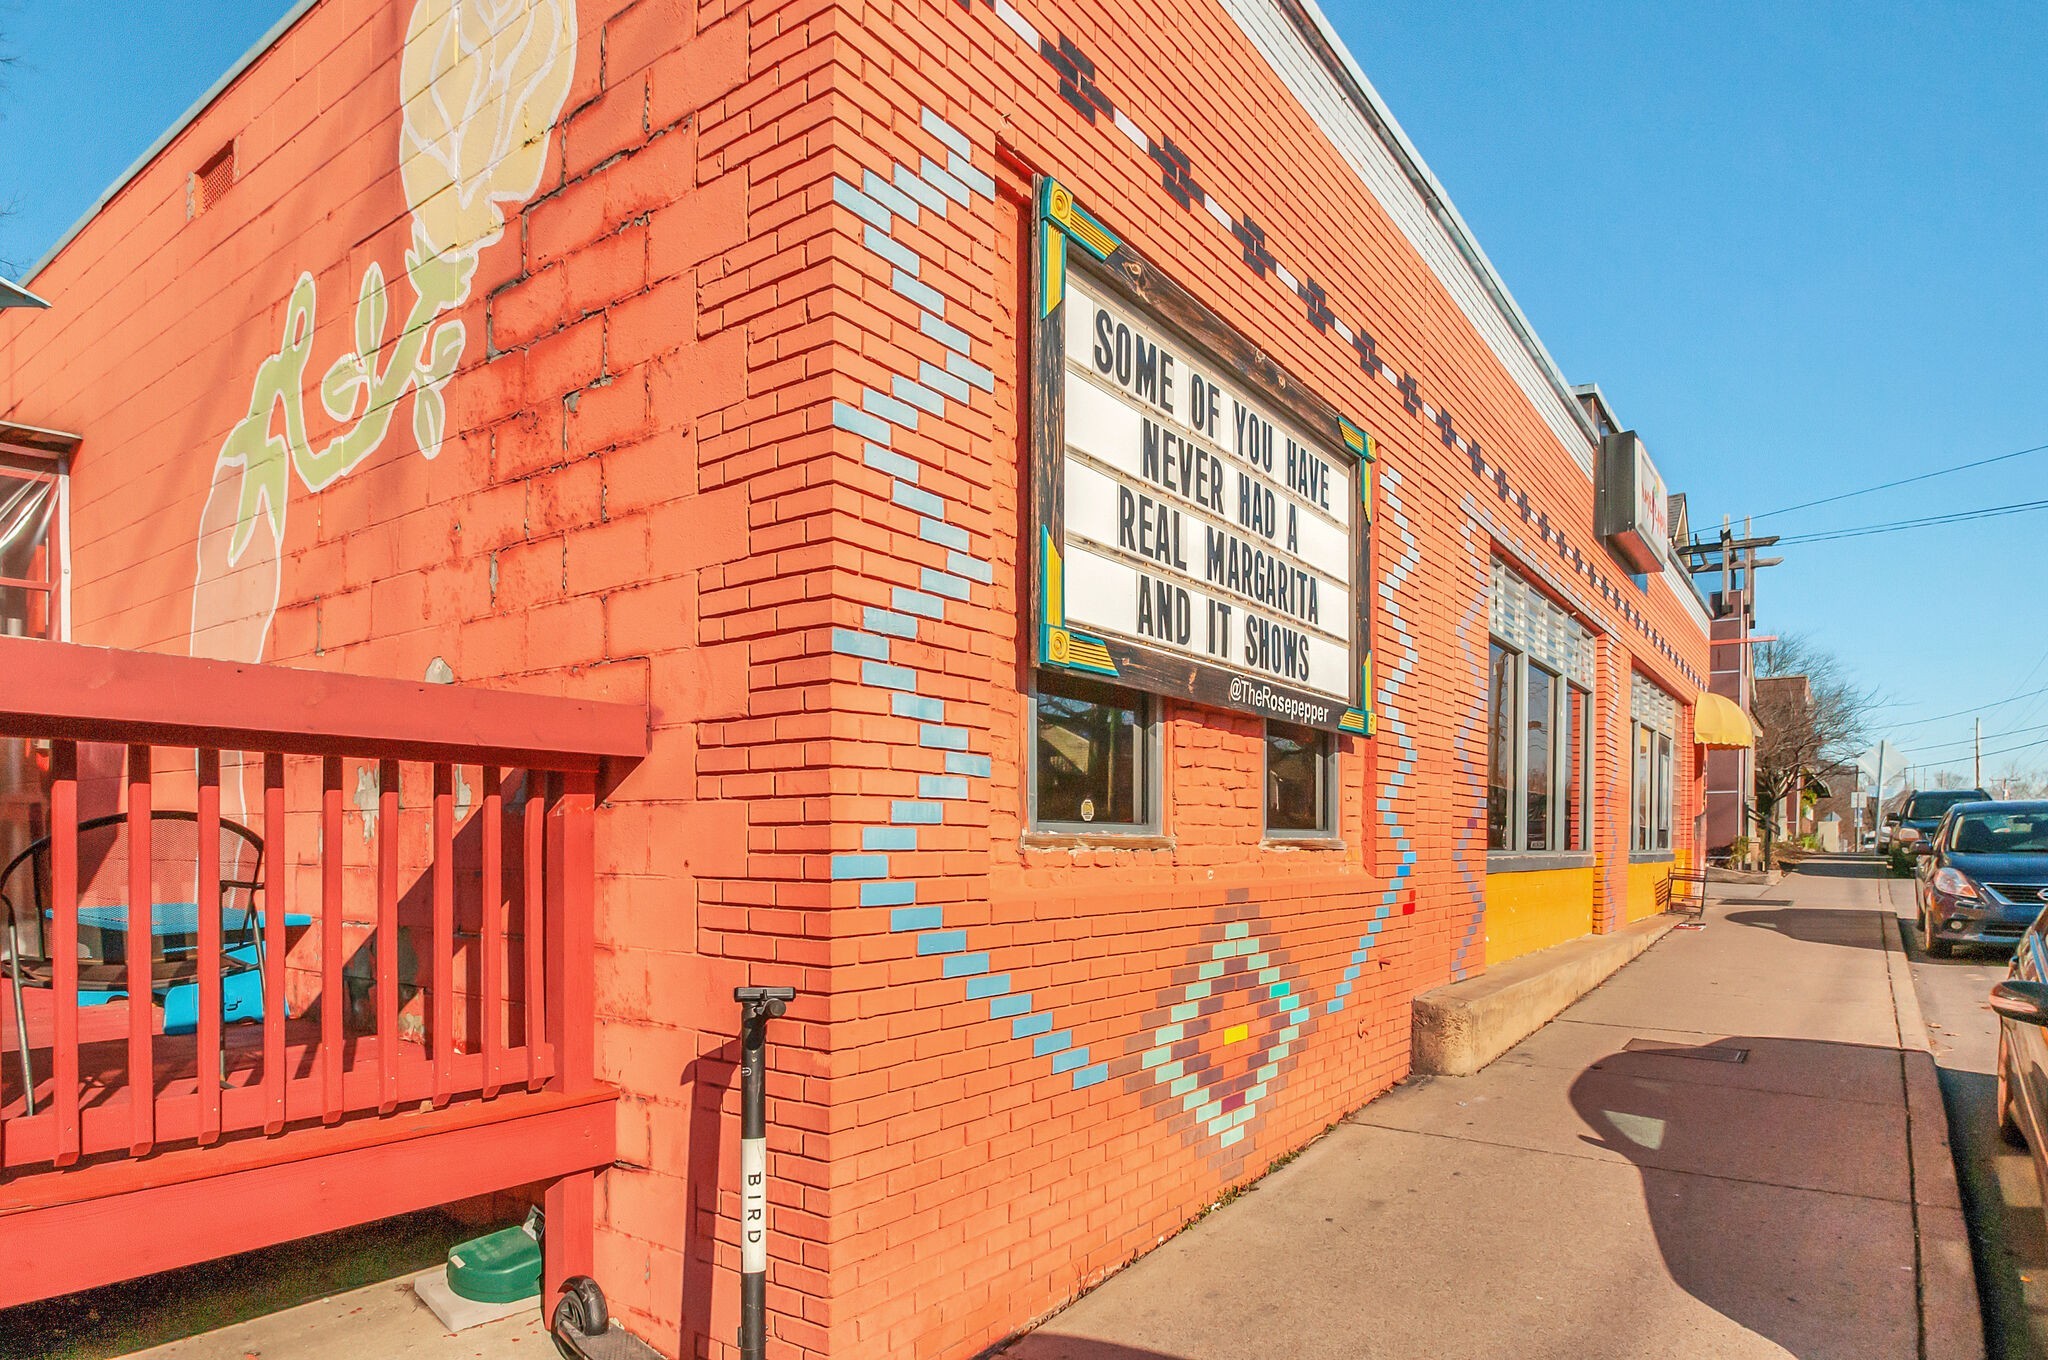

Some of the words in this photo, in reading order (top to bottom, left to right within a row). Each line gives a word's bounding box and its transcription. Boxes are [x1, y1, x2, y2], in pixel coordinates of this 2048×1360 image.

[1094, 309, 1174, 415] SOME
[1191, 373, 1220, 439] OF
[1233, 400, 1273, 474] YOU
[1286, 437, 1329, 510] HAVE
[1142, 417, 1225, 515] NEVER
[1239, 472, 1276, 540] HAD
[1287, 503, 1298, 553] A
[1119, 484, 1187, 572] REAL
[1206, 525, 1319, 625] MARGARITA
[1137, 574, 1191, 646] AND
[1208, 599, 1231, 658] IT
[1245, 614, 1310, 683] SHOWS
[1229, 677, 1329, 725] @TheRosepepper
[748, 1171, 761, 1244] BIRD
